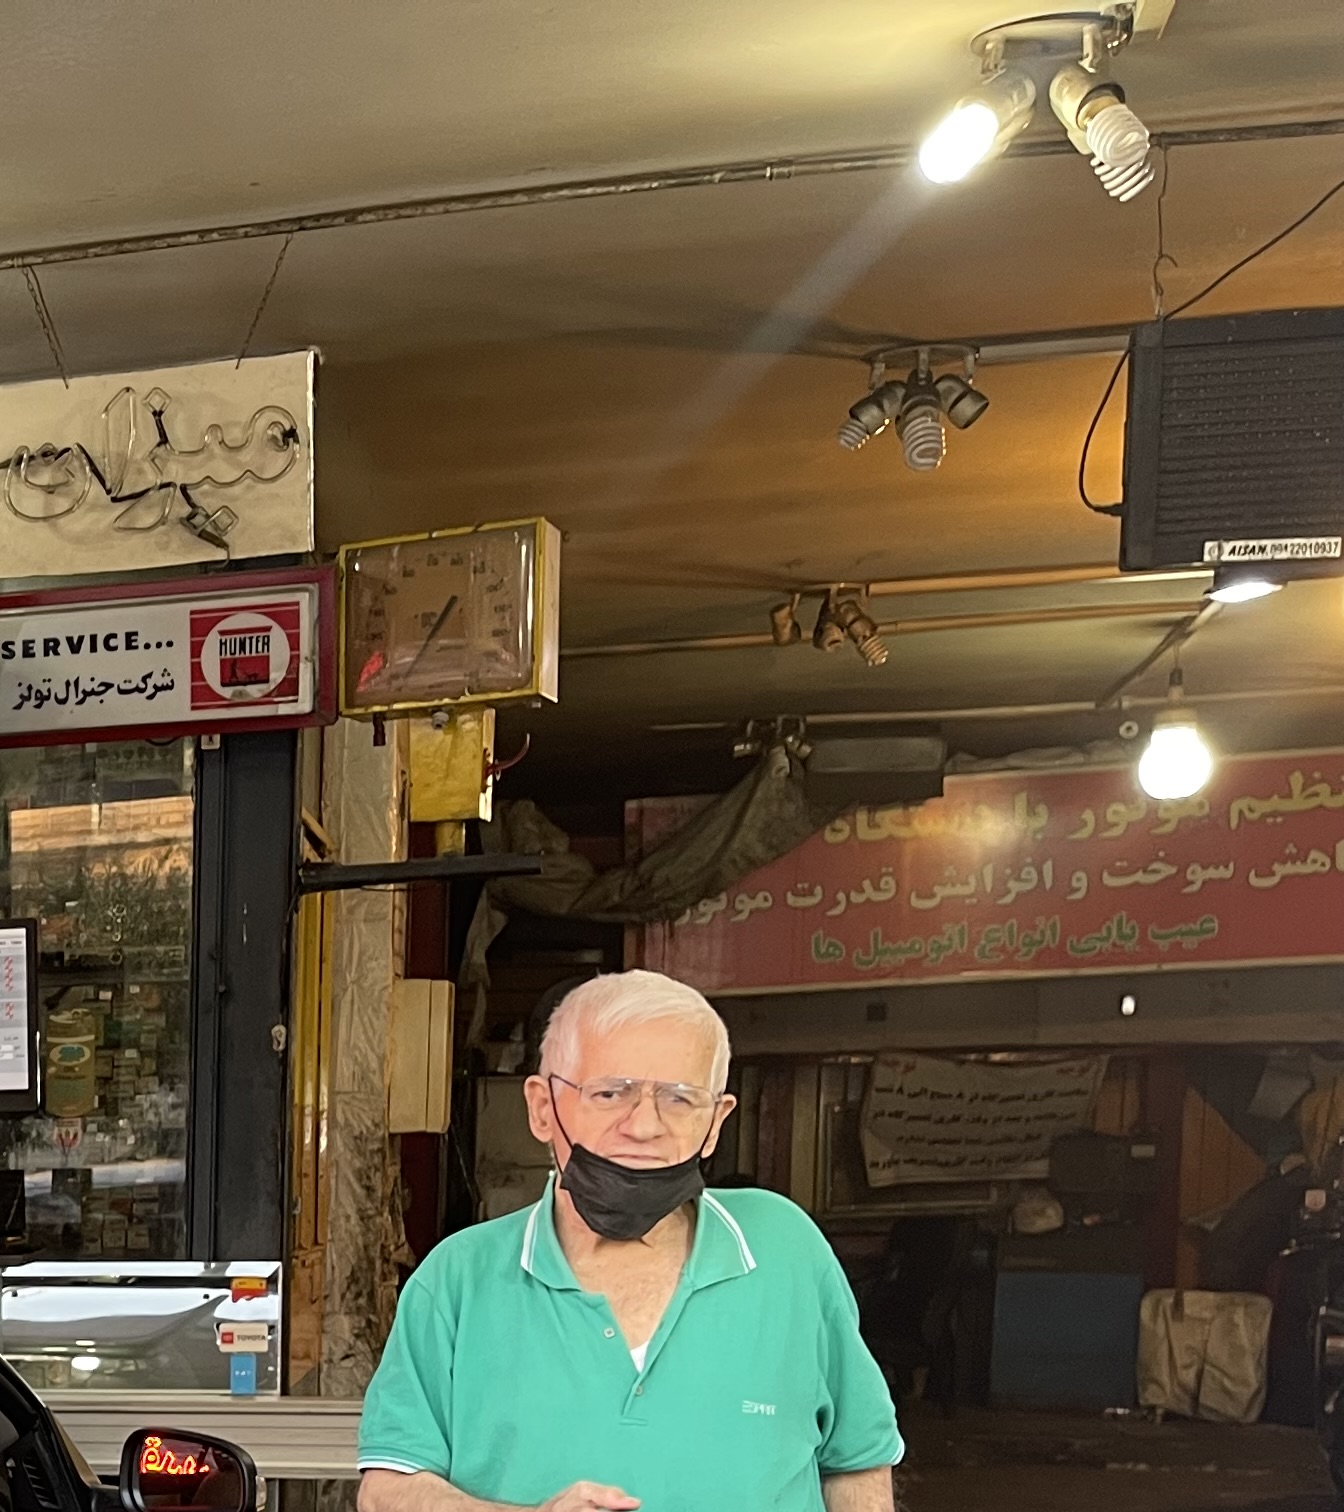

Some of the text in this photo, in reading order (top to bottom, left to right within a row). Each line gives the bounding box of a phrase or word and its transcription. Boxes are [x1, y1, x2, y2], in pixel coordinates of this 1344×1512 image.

[218, 634, 271, 658] HUNTER
[12, 667, 175, 711] شرکت جنرال تولز
[1229, 769, 1344, 831] نظیم
[910, 856, 1053, 911] افزایش
[1066, 870, 1088, 900] و
[1101, 851, 1235, 894] سوخت
[1248, 839, 1344, 888] اهش
[787, 866, 898, 916] قدرت
[812, 929, 845, 964] ها
[854, 921, 968, 970] اتومبیل
[977, 914, 1060, 963] انواع
[1148, 913, 1218, 950] عیب
